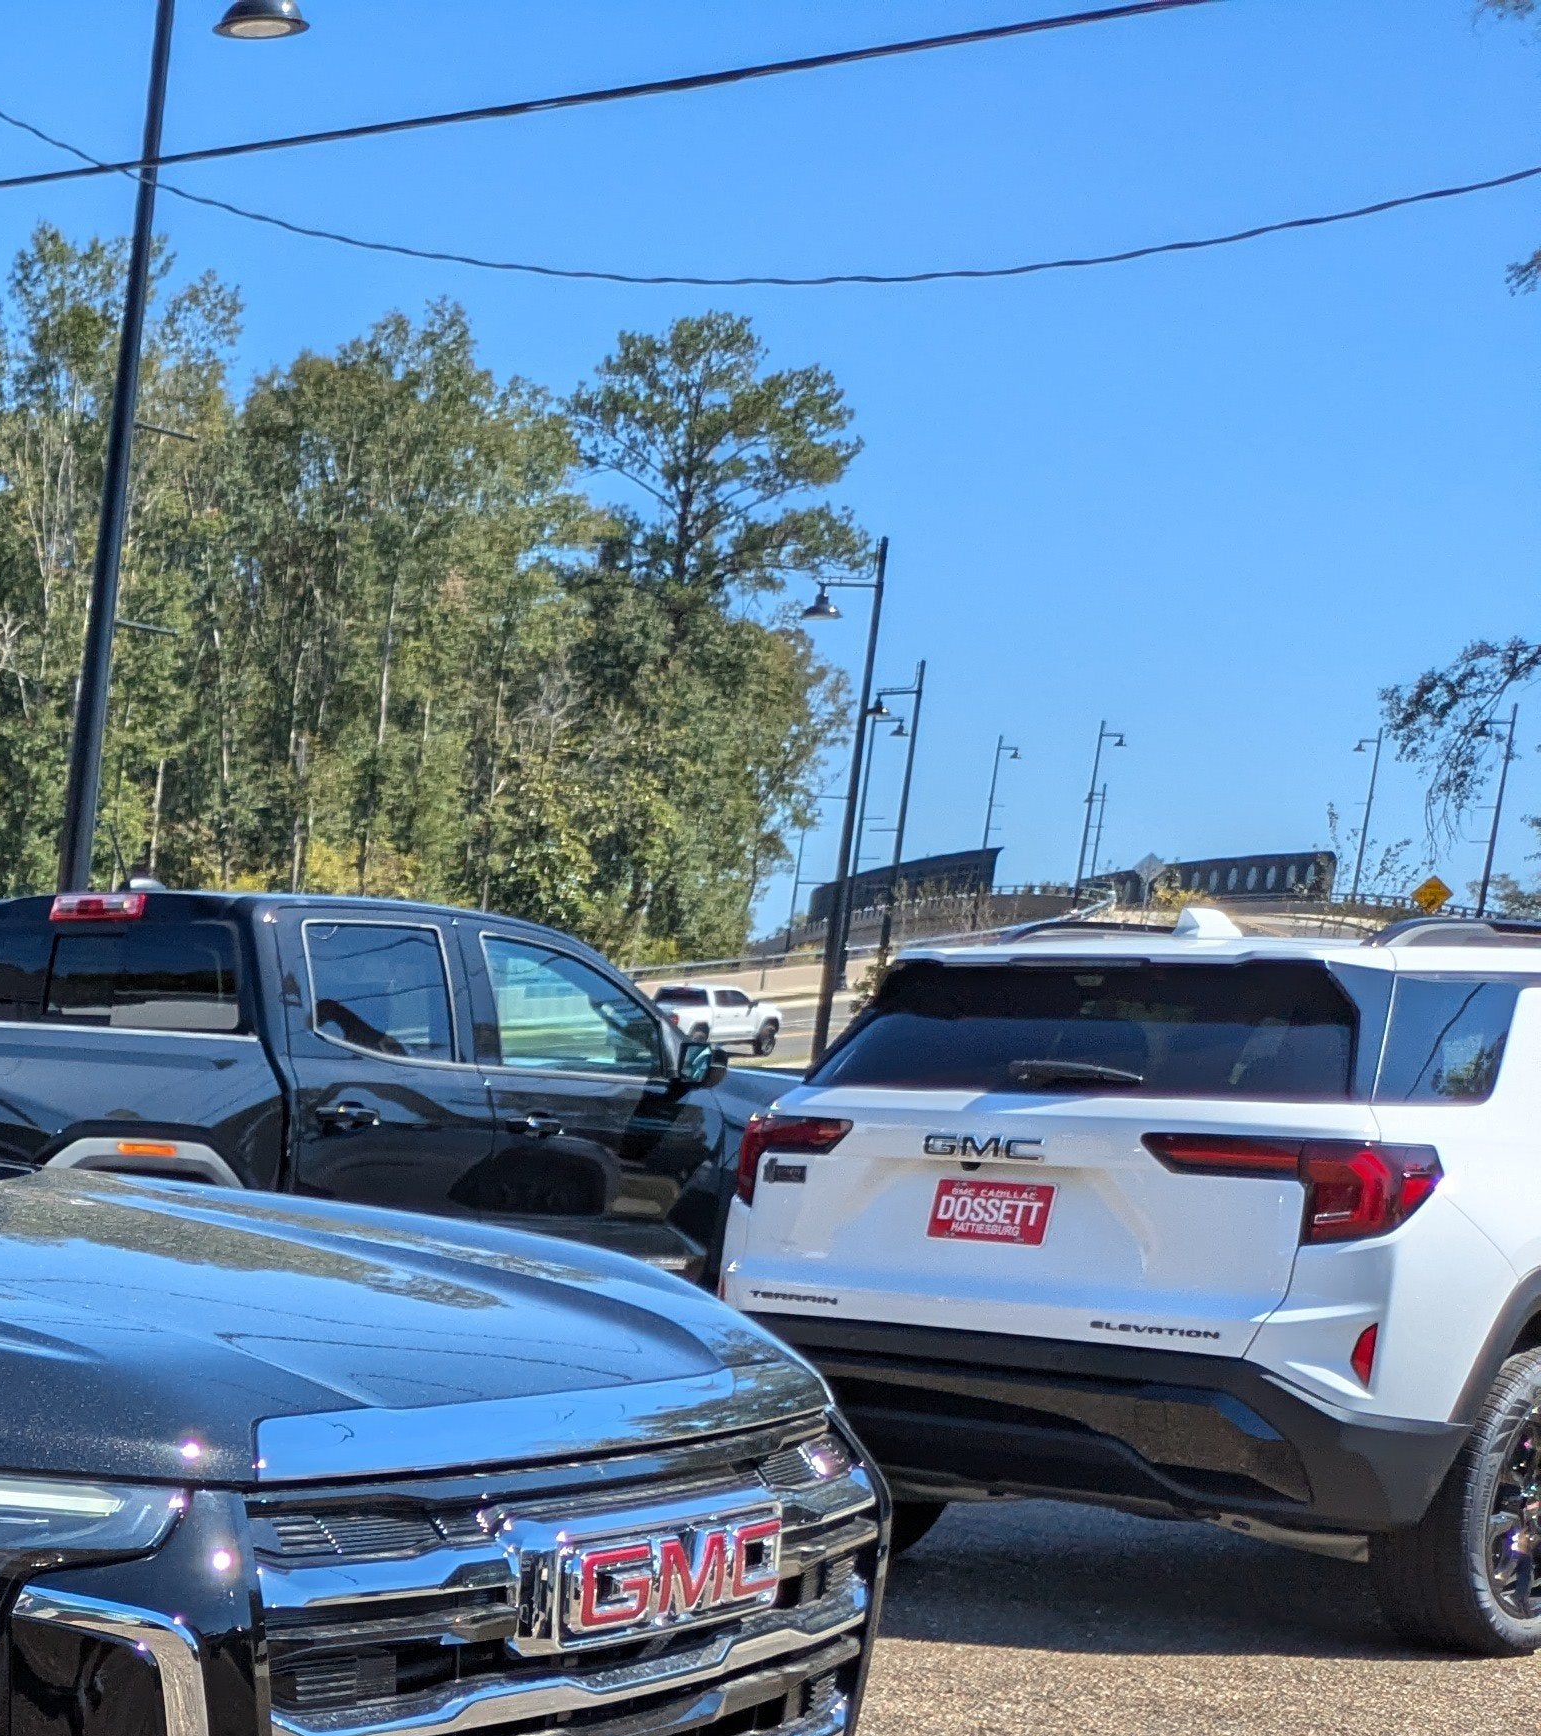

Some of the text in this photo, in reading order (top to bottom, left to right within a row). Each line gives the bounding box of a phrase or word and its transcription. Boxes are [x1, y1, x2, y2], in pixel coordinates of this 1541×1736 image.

[923, 1133, 1045, 1162] GMC
[951, 1187, 1038, 1200] GMC CADILLAC
[937, 1196, 1043, 1226] DOSSETT
[950, 1221, 1020, 1237] HATTIESBURG
[749, 1288, 839, 1306] TERRAIN
[1089, 1319, 1221, 1341] ELEVATION
[578, 1518, 783, 1631] GMC
